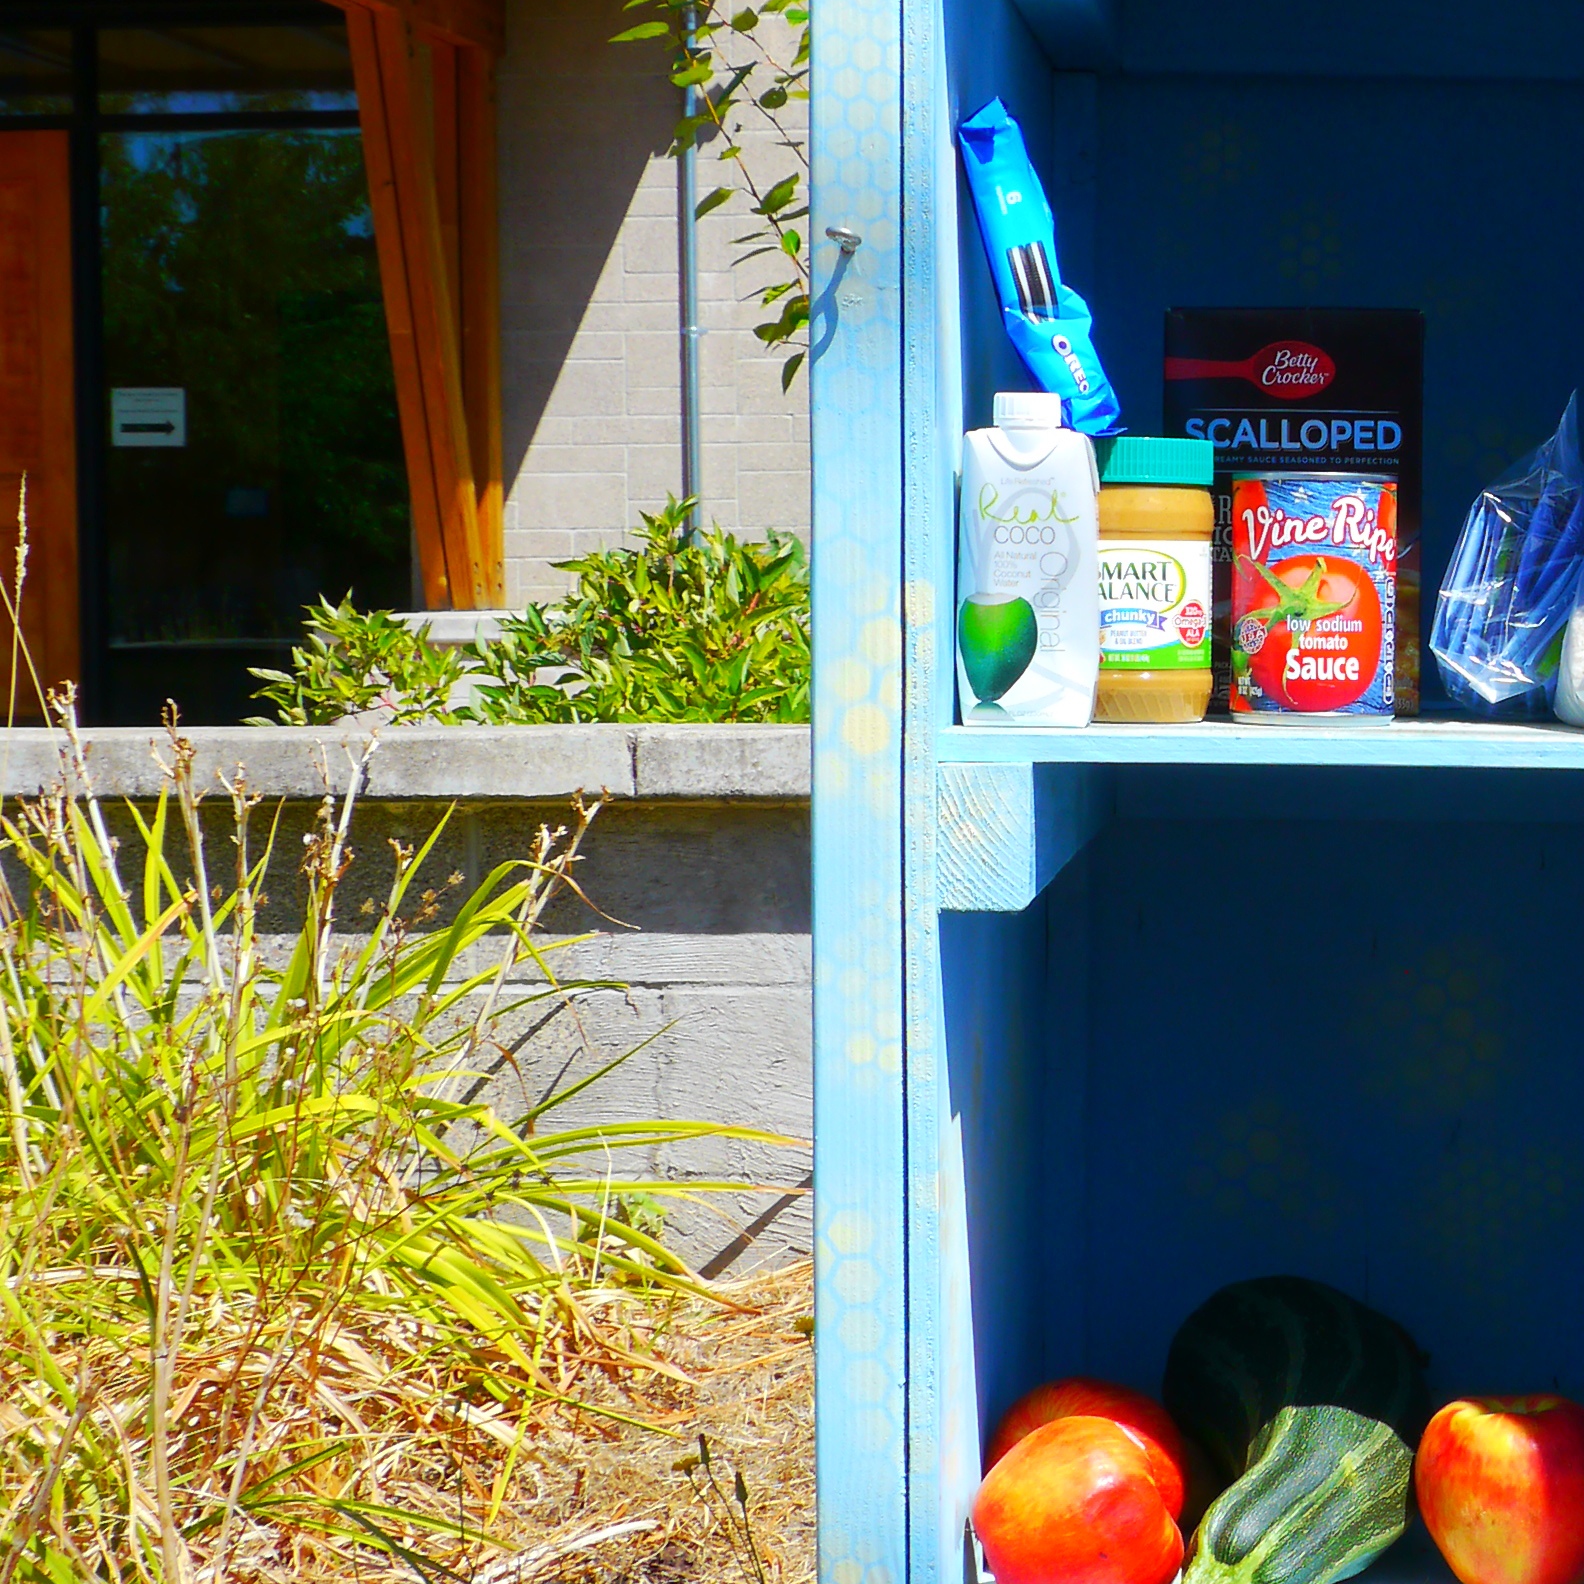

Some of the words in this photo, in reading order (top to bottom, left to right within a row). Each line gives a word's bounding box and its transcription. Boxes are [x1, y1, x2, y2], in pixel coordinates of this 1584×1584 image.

[1051, 334, 1090, 394] OREO
[1274, 349, 1319, 373] Betty
[1261, 365, 1326, 386] Crocker
[1185, 418, 1402, 451] SCALLOPED
[1215, 455, 1245, 463] REAMY
[1249, 455, 1276, 463] SAUCE
[1279, 456, 1327, 464] SEASONED
[1344, 457, 1400, 465] PERFECTION
[979, 482, 1080, 525] Real
[994, 525, 1056, 545] COCO
[1241, 504, 1329, 562] Vine
[1331, 495, 1396, 564] Ripe
[993, 569, 1031, 578] Coconut
[1098, 561, 1172, 581] MART
[1033, 551, 1068, 652] Original
[1097, 582, 1174, 603] ALANCE
[1104, 609, 1155, 626] chunky
[1286, 614, 1311, 632] low
[1316, 615, 1363, 633] sodium
[1299, 634, 1349, 651] tomato
[1285, 648, 1360, 681] Sauce
